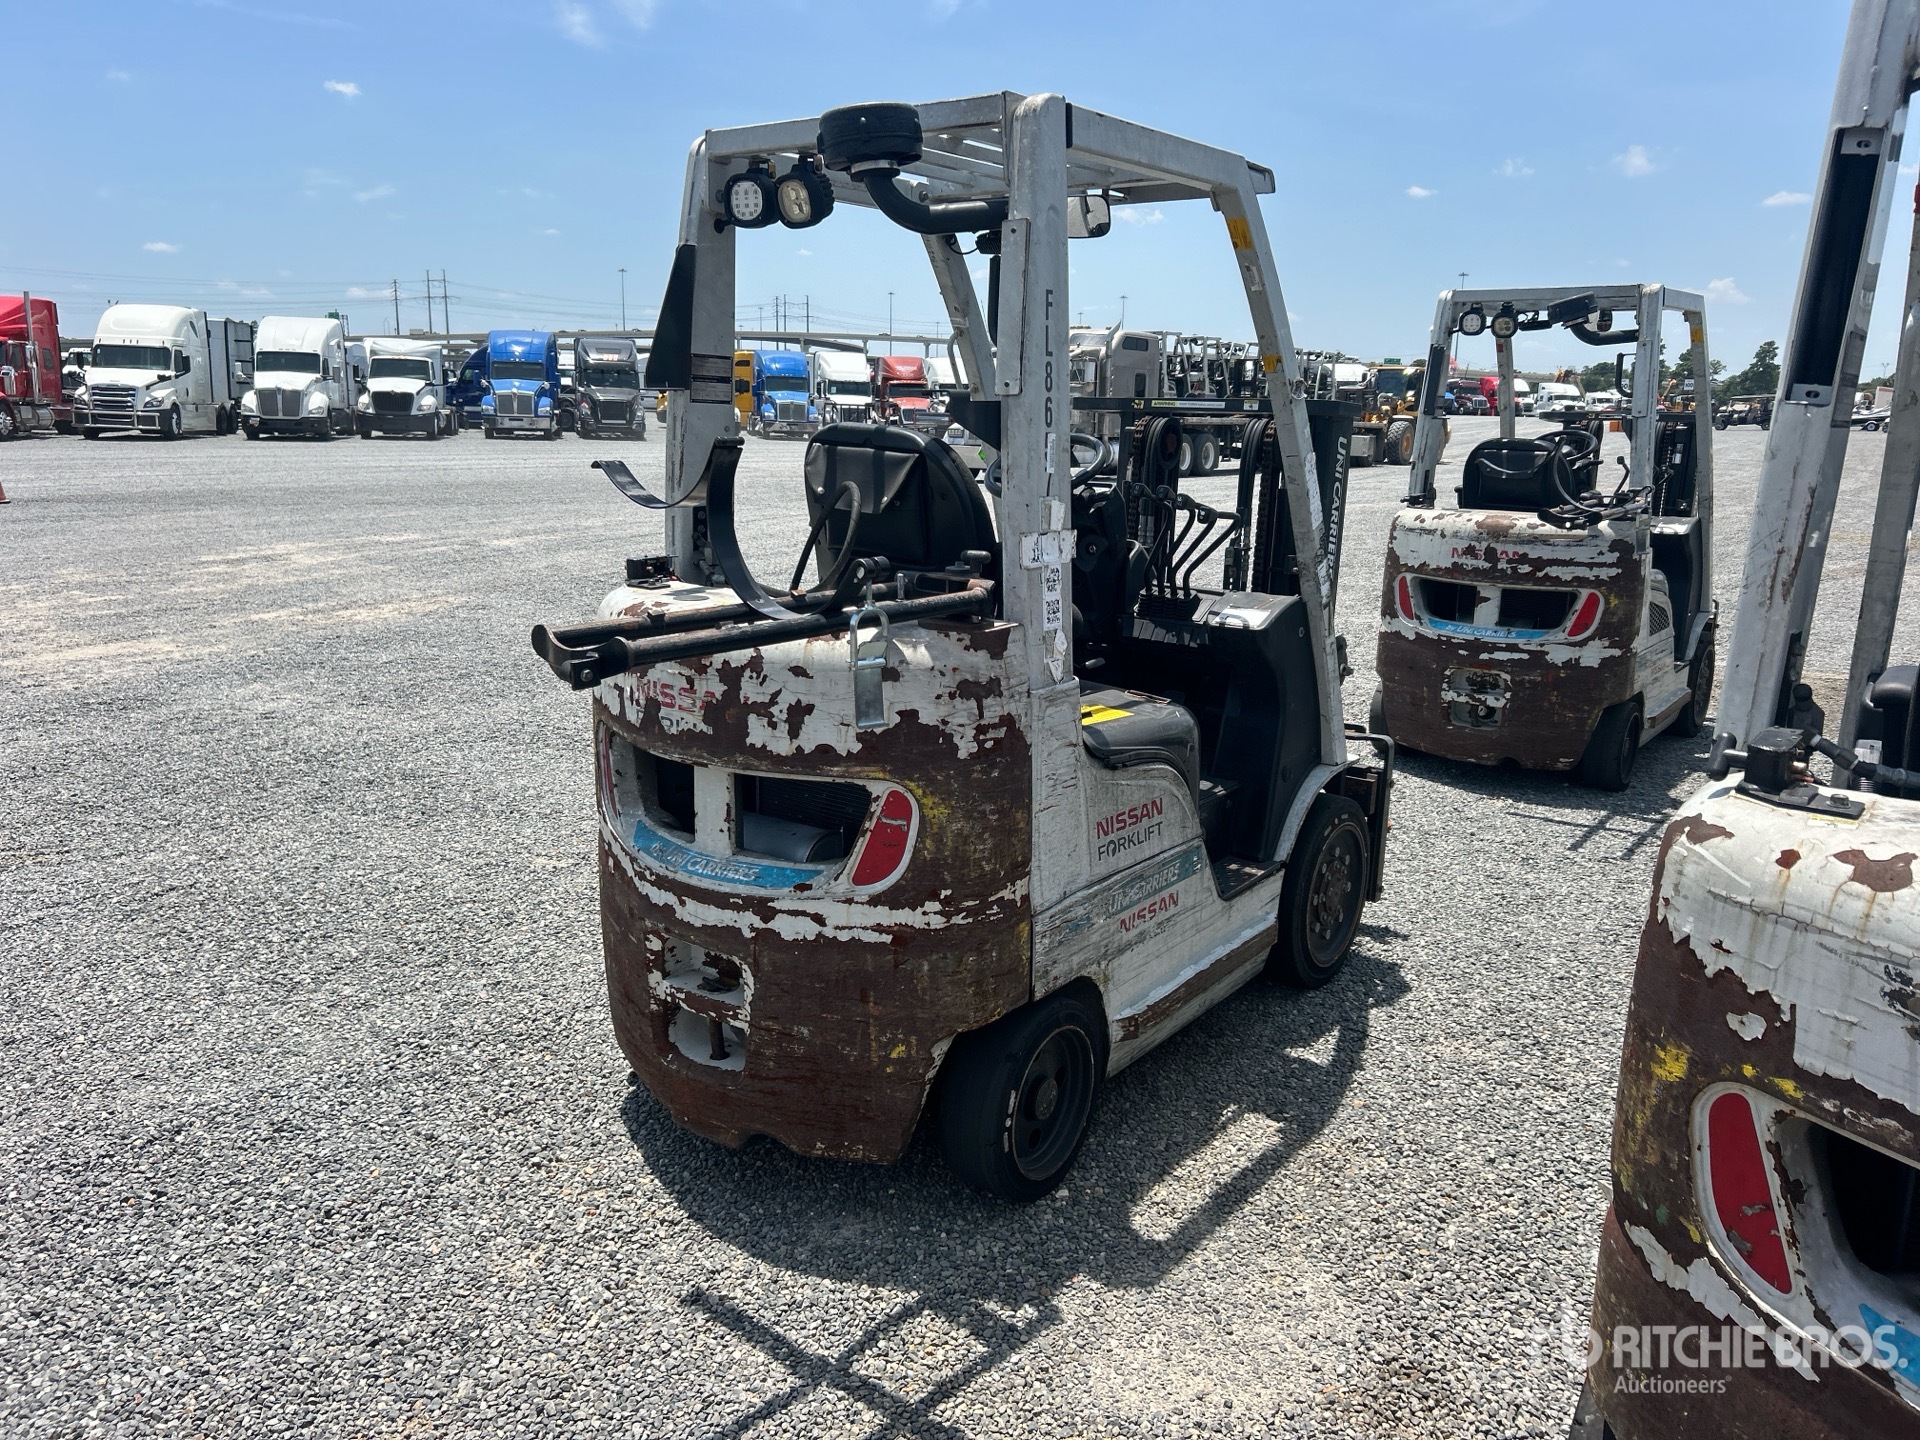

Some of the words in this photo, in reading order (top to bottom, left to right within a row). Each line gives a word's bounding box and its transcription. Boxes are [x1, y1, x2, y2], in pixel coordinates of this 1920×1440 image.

[1096, 797, 1163, 839] NISSAN
[1098, 821, 1163, 861] FORKLIFT
[1120, 889, 1179, 933] NISSAN
